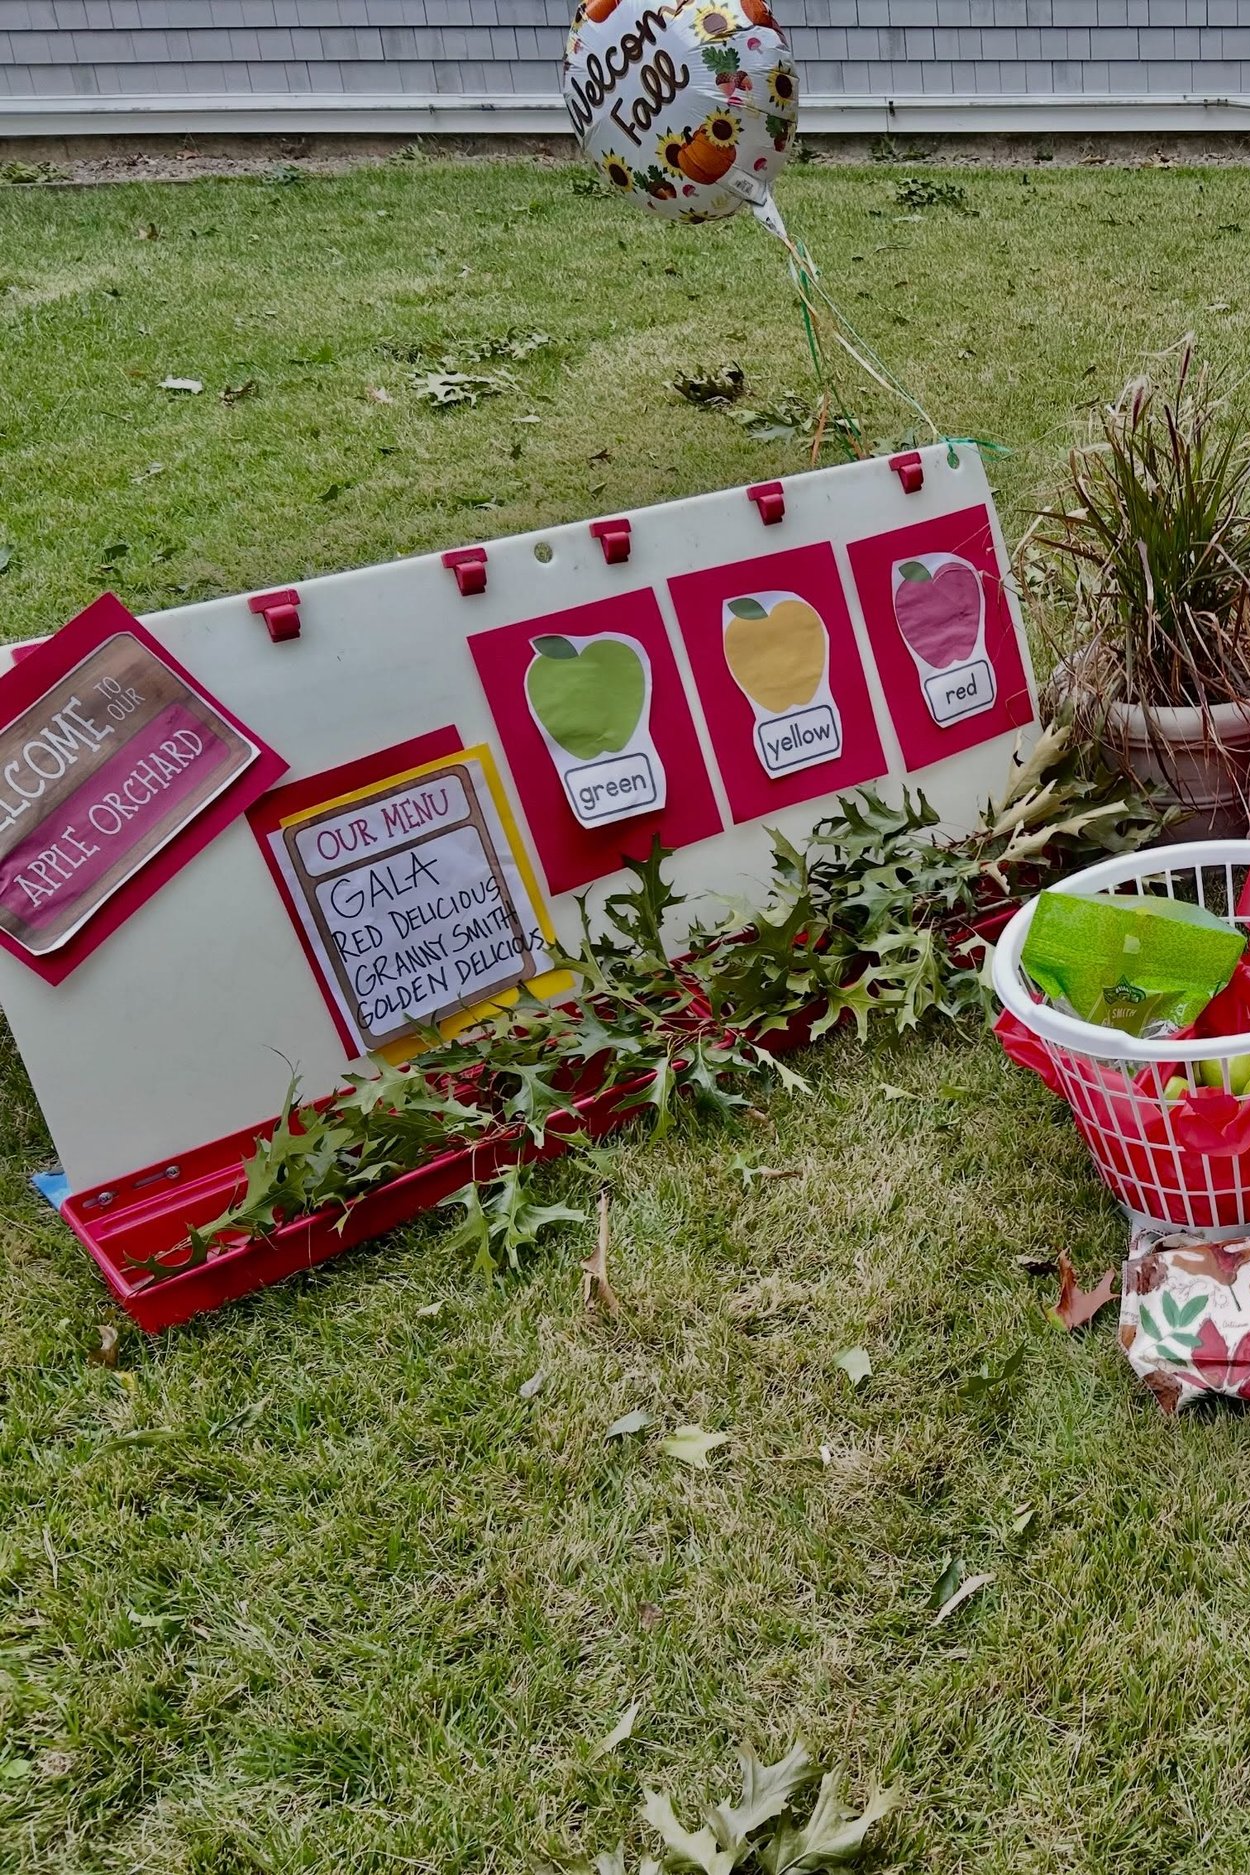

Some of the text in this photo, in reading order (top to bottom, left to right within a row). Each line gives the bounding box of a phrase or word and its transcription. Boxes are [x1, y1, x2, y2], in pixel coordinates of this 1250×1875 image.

[609, 49, 690, 147] Fall
[93, 675, 122, 701] TO
[107, 687, 146, 721] OUR
[945, 673, 978, 705] red
[0, 695, 115, 833] LCOME
[766, 721, 832, 761] yellow
[14, 728, 204, 909] APPLE ORCHARD
[316, 788, 450, 861] OUR MENU
[579, 772, 648, 811] green
[330, 851, 441, 919] GALA
[331, 876, 502, 963] RED DELICIOUS
[354, 900, 519, 998] GRANNY SMITH
[355, 927, 546, 1030] GOLDEN DELICIOUS
[1111, 1007, 1138, 1020] SMITH
